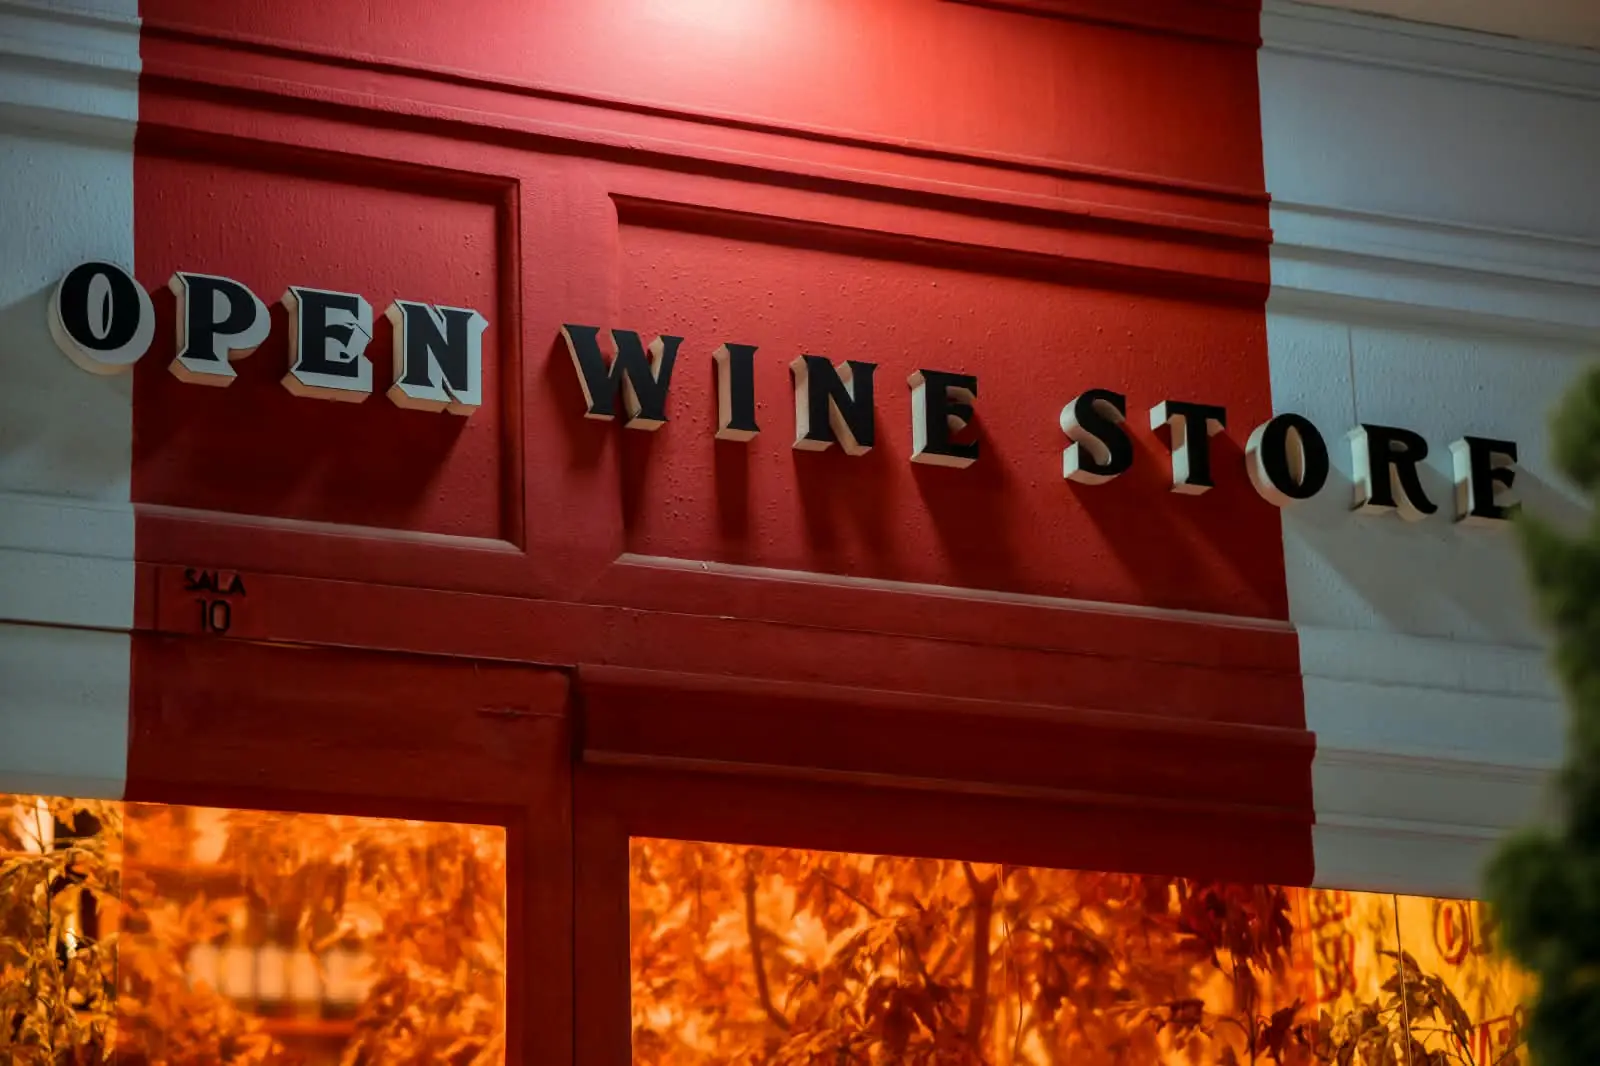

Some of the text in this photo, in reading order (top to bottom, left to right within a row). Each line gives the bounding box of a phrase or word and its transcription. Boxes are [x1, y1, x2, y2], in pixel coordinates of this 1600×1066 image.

[50, 260, 1520, 523] OPEN WINE STORE
[184, 567, 246, 597] SALA
[196, 598, 231, 634] 10
